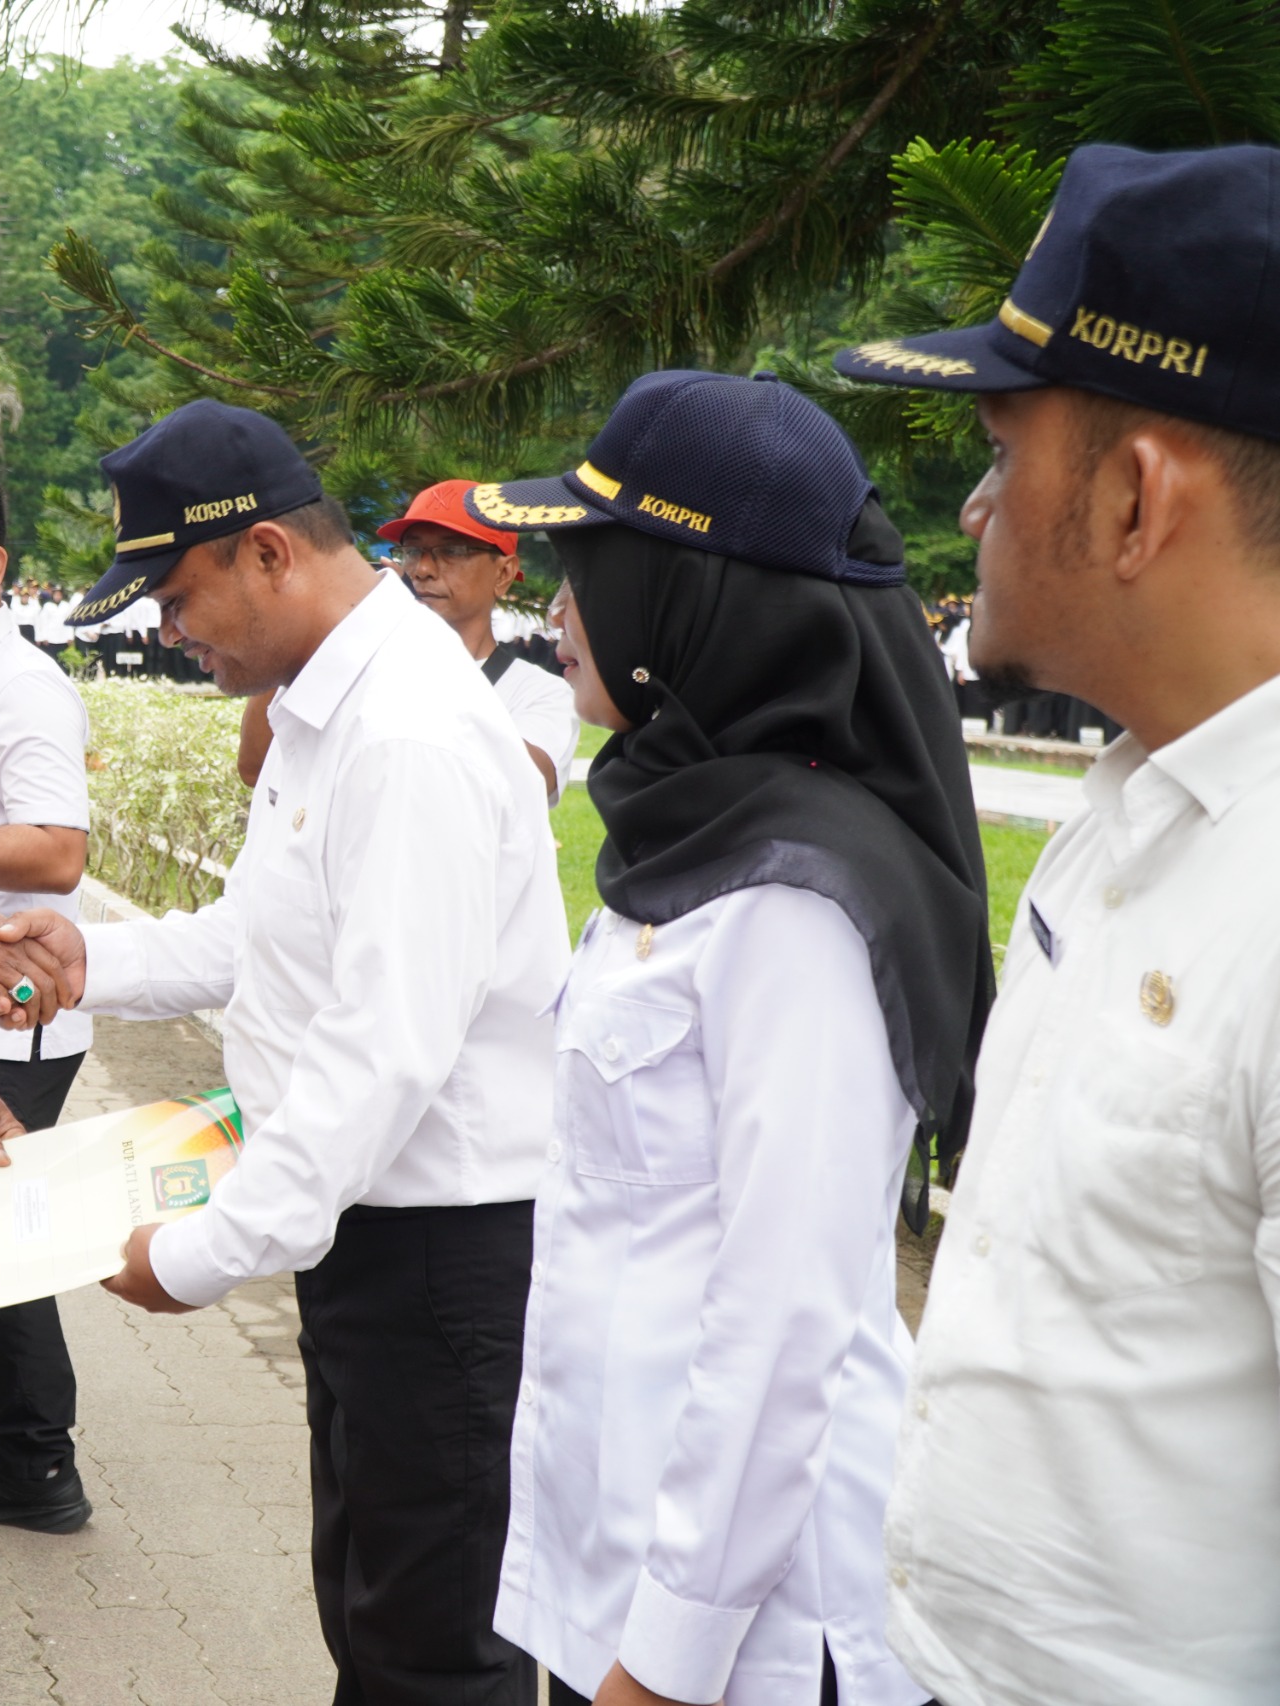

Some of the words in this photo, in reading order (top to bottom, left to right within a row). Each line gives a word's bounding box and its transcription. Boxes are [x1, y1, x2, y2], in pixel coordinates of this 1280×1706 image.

[1070, 305, 1208, 377] KORPRI
[183, 492, 258, 525] KORPRI
[638, 494, 712, 533] KORPRI
[121, 1139, 138, 1185] BUPATI
[128, 1188, 144, 1228] LANG
